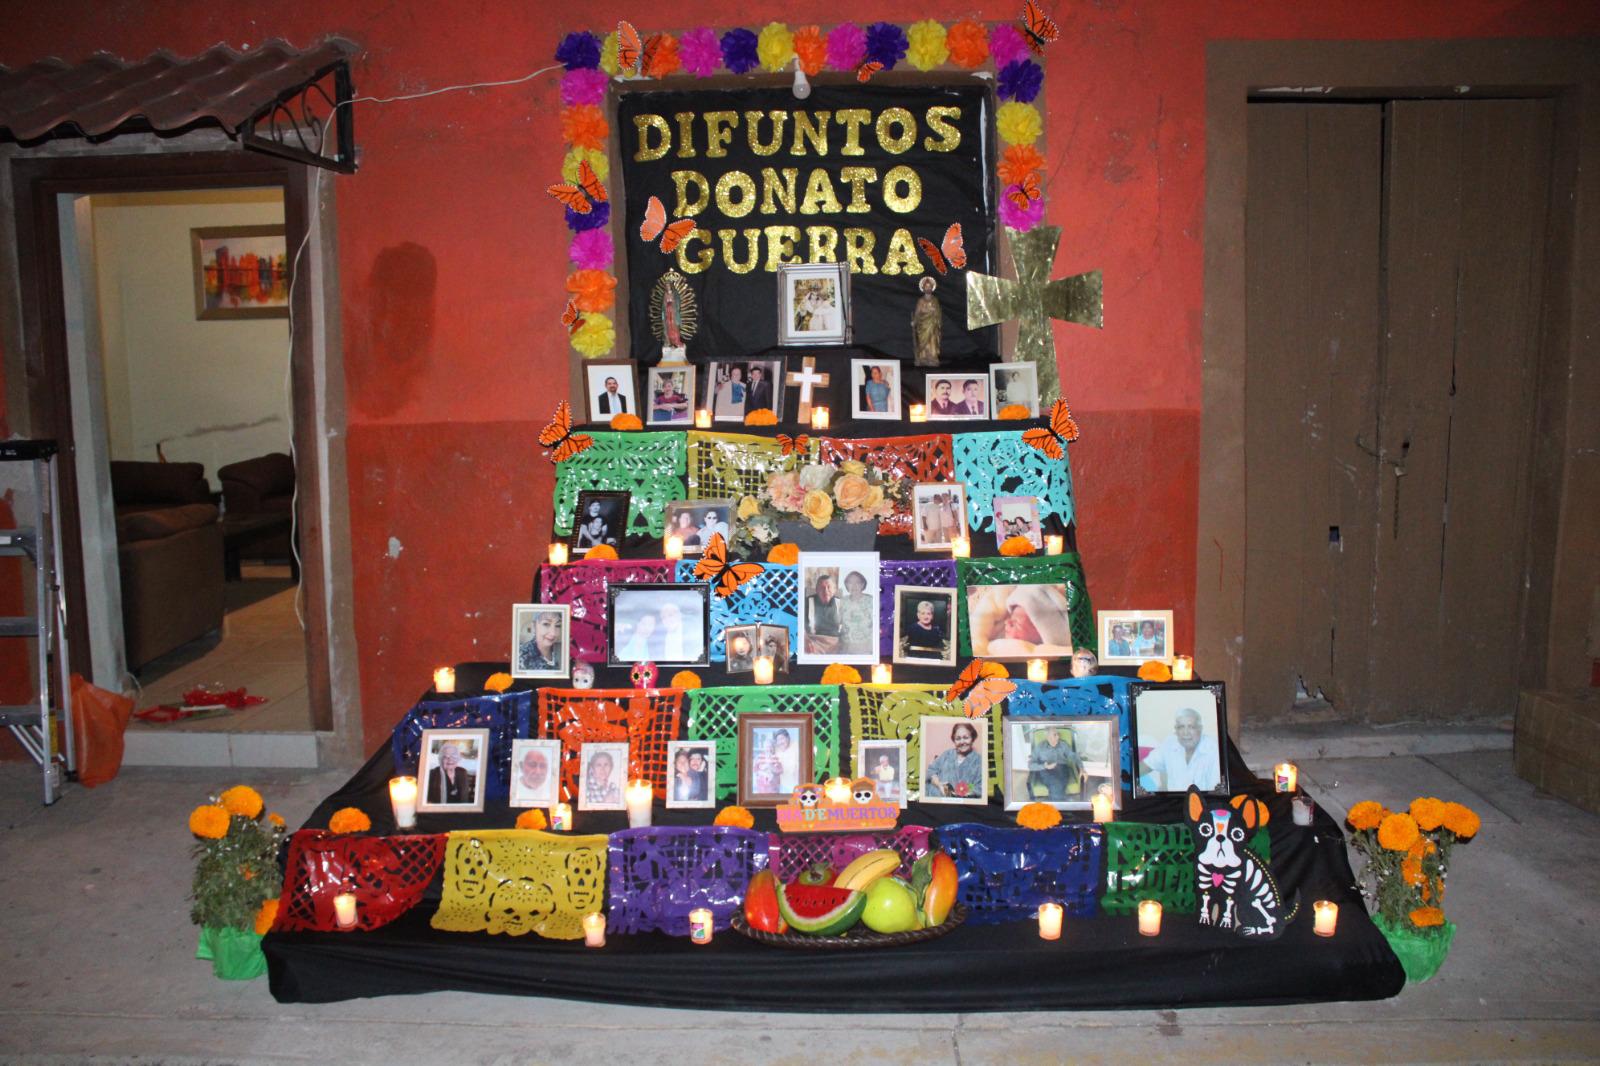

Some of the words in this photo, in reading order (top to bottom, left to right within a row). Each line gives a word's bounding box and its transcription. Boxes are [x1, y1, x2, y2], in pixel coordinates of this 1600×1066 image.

[633, 106, 962, 161] DIFUNTOS
[671, 165, 923, 218] DONATO
[675, 225, 925, 276] GUERRA
[803, 808, 827, 821] DE
[828, 806, 897, 820] MUERTOS
